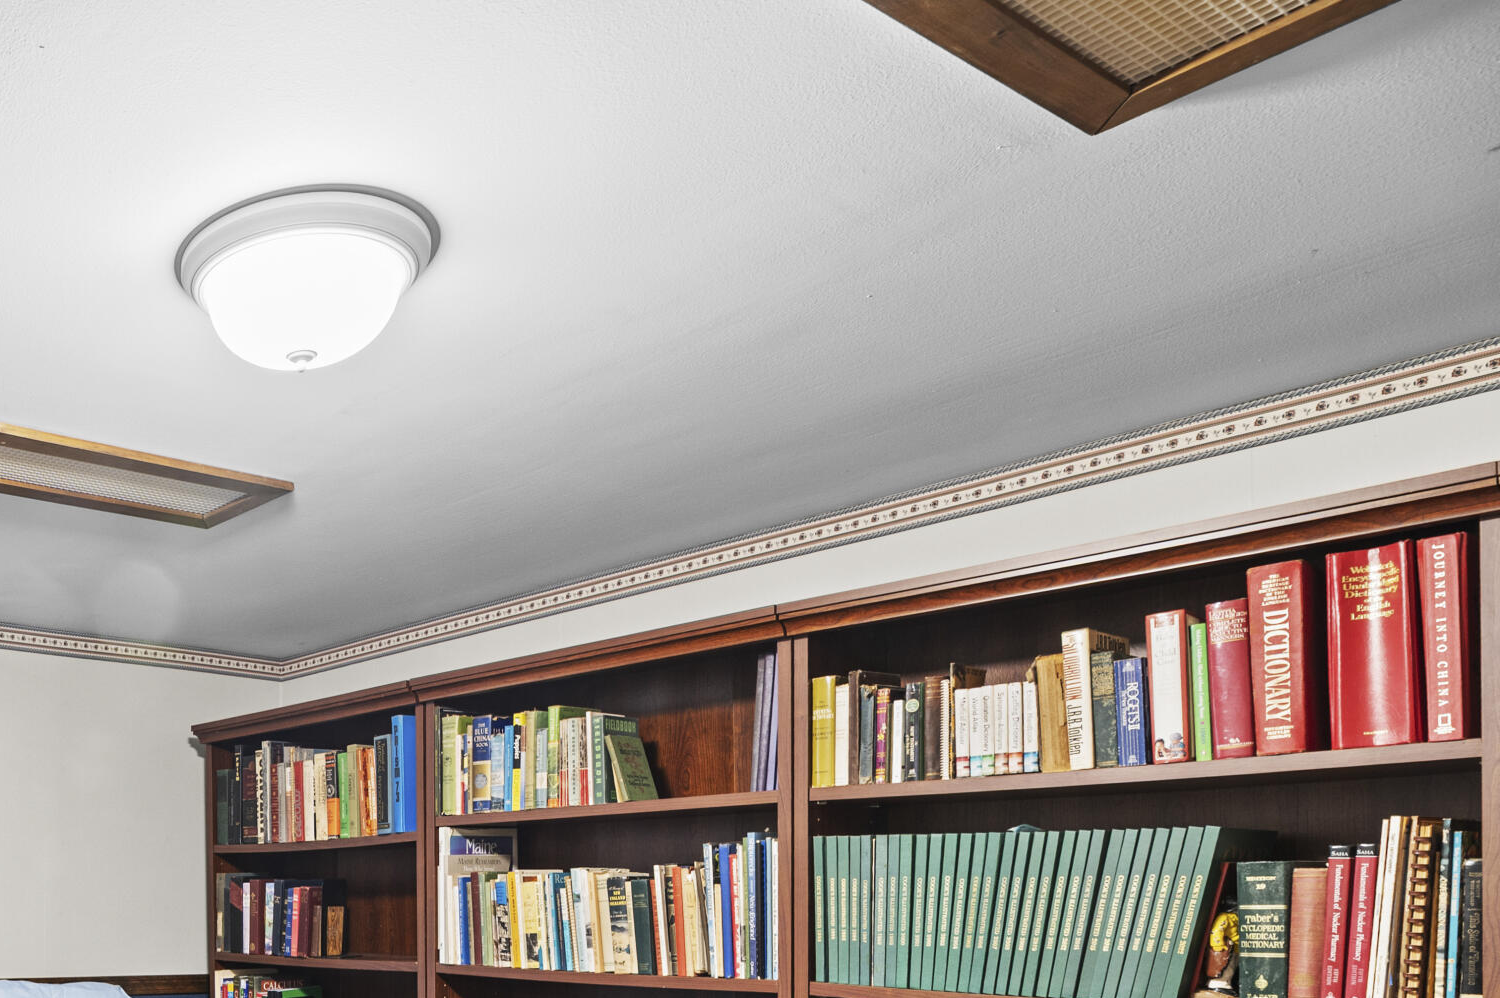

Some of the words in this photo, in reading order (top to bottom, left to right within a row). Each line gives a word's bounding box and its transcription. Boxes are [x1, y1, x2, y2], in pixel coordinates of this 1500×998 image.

[1431, 543, 1446, 609] JOURNEY
[1435, 617, 1447, 653] INTO
[1263, 608, 1291, 722] DICTIONARY
[1436, 660, 1449, 707] CHINA
[605, 718, 637, 733] FIELDBOOK
[466, 838, 497, 854] Maine
[1333, 864, 1344, 903] Fundamentals
[1359, 862, 1369, 901] Fundamentals
[1240, 925, 1285, 933] CYCLOPEDIC
[1244, 913, 1279, 924] Taber's
[1331, 912, 1340, 933] Nuclear
[1356, 911, 1366, 932] Nuclear
[1241, 940, 1285, 949] DICTIONARY
[1328, 934, 1339, 962] Pharmacy
[1352, 934, 1364, 962] Pharmacy
